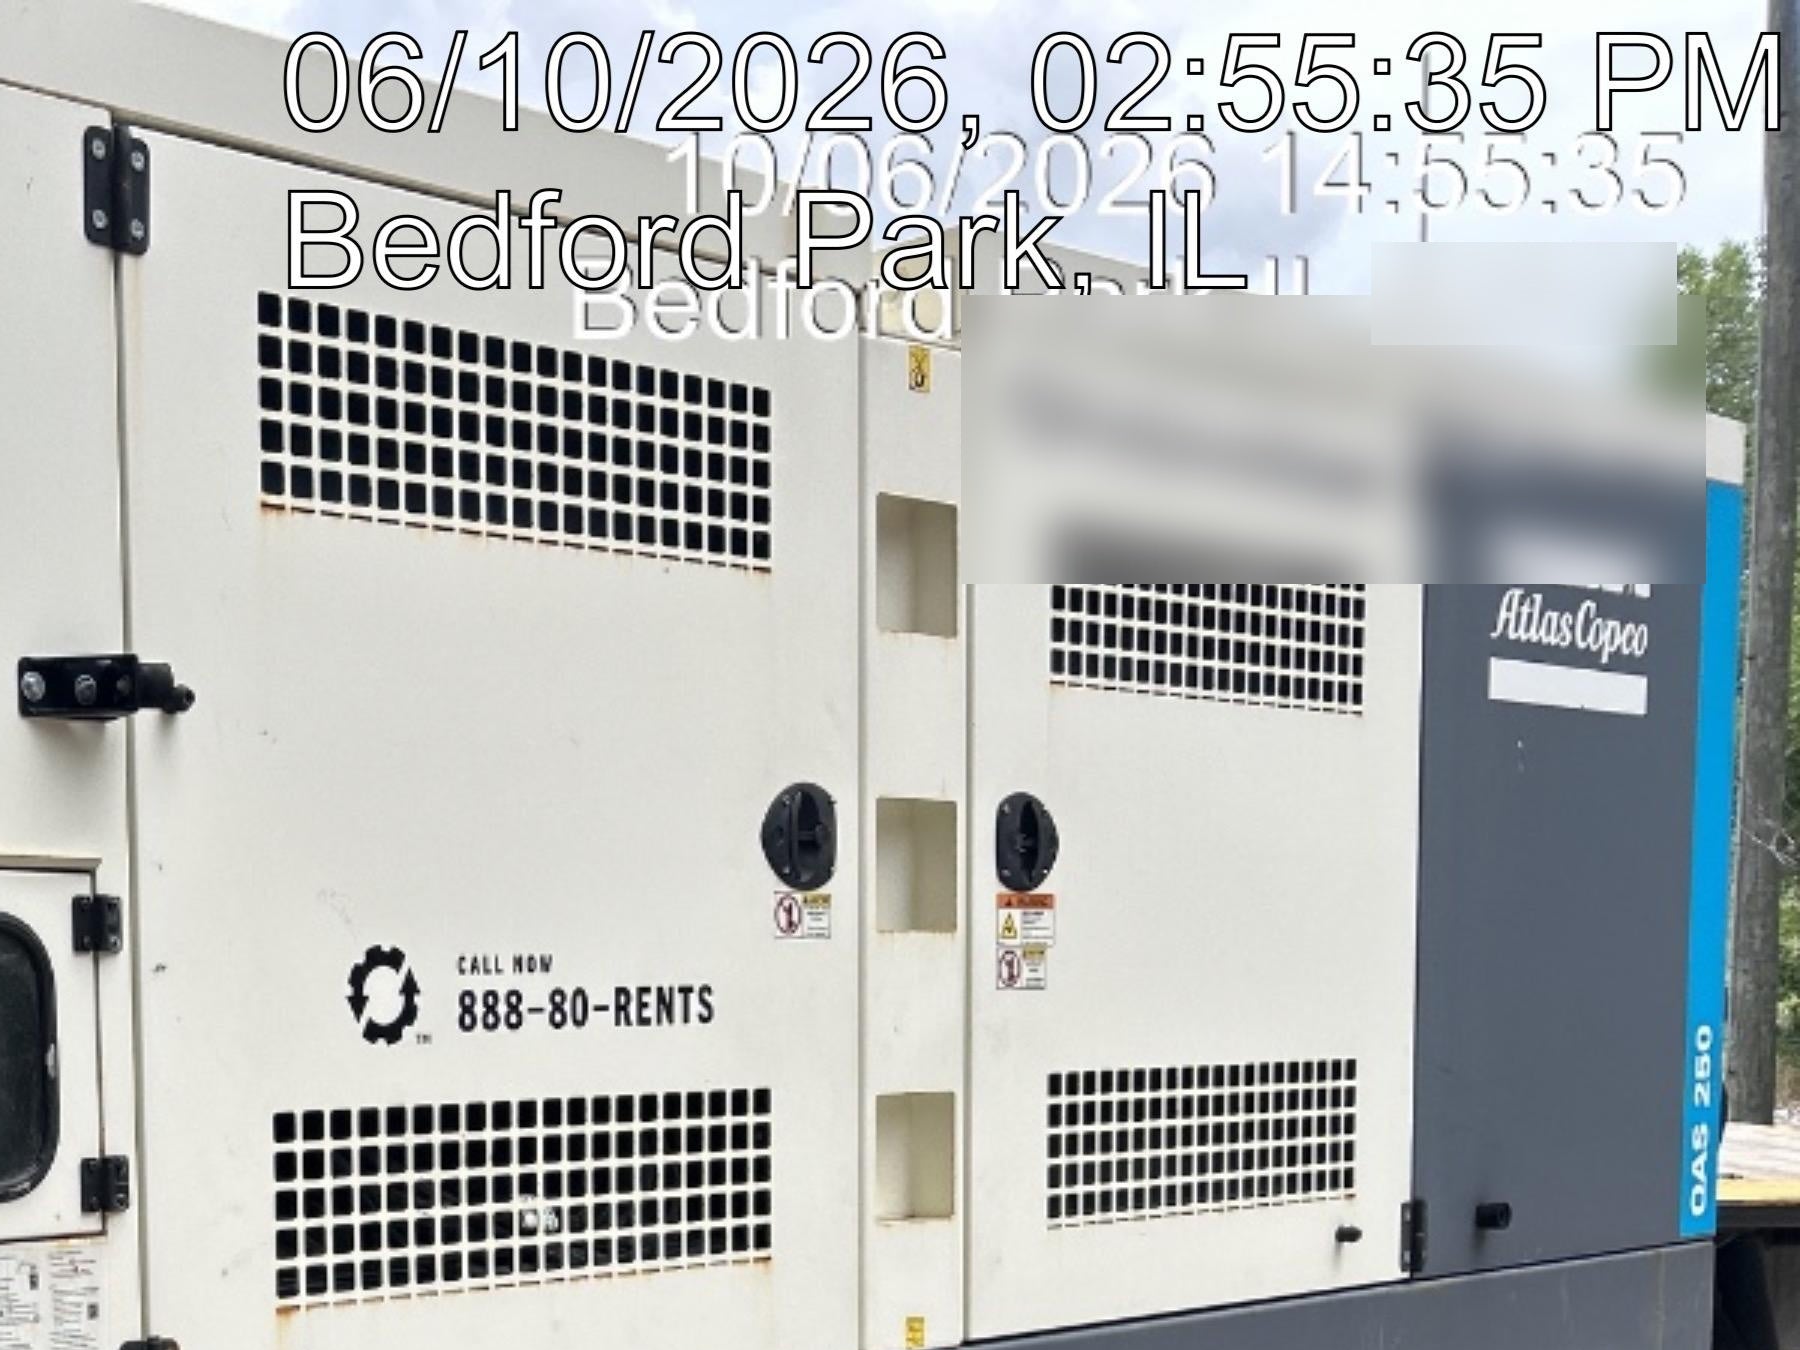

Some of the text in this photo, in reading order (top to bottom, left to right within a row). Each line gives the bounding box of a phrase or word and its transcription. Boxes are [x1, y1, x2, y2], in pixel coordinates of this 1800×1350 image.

[1490, 587, 1649, 665] Atlas Copco
[456, 953, 554, 976] CALL NOW
[457, 984, 715, 1032] 888-80-RENTS
[1693, 1024, 1714, 1108] 250
